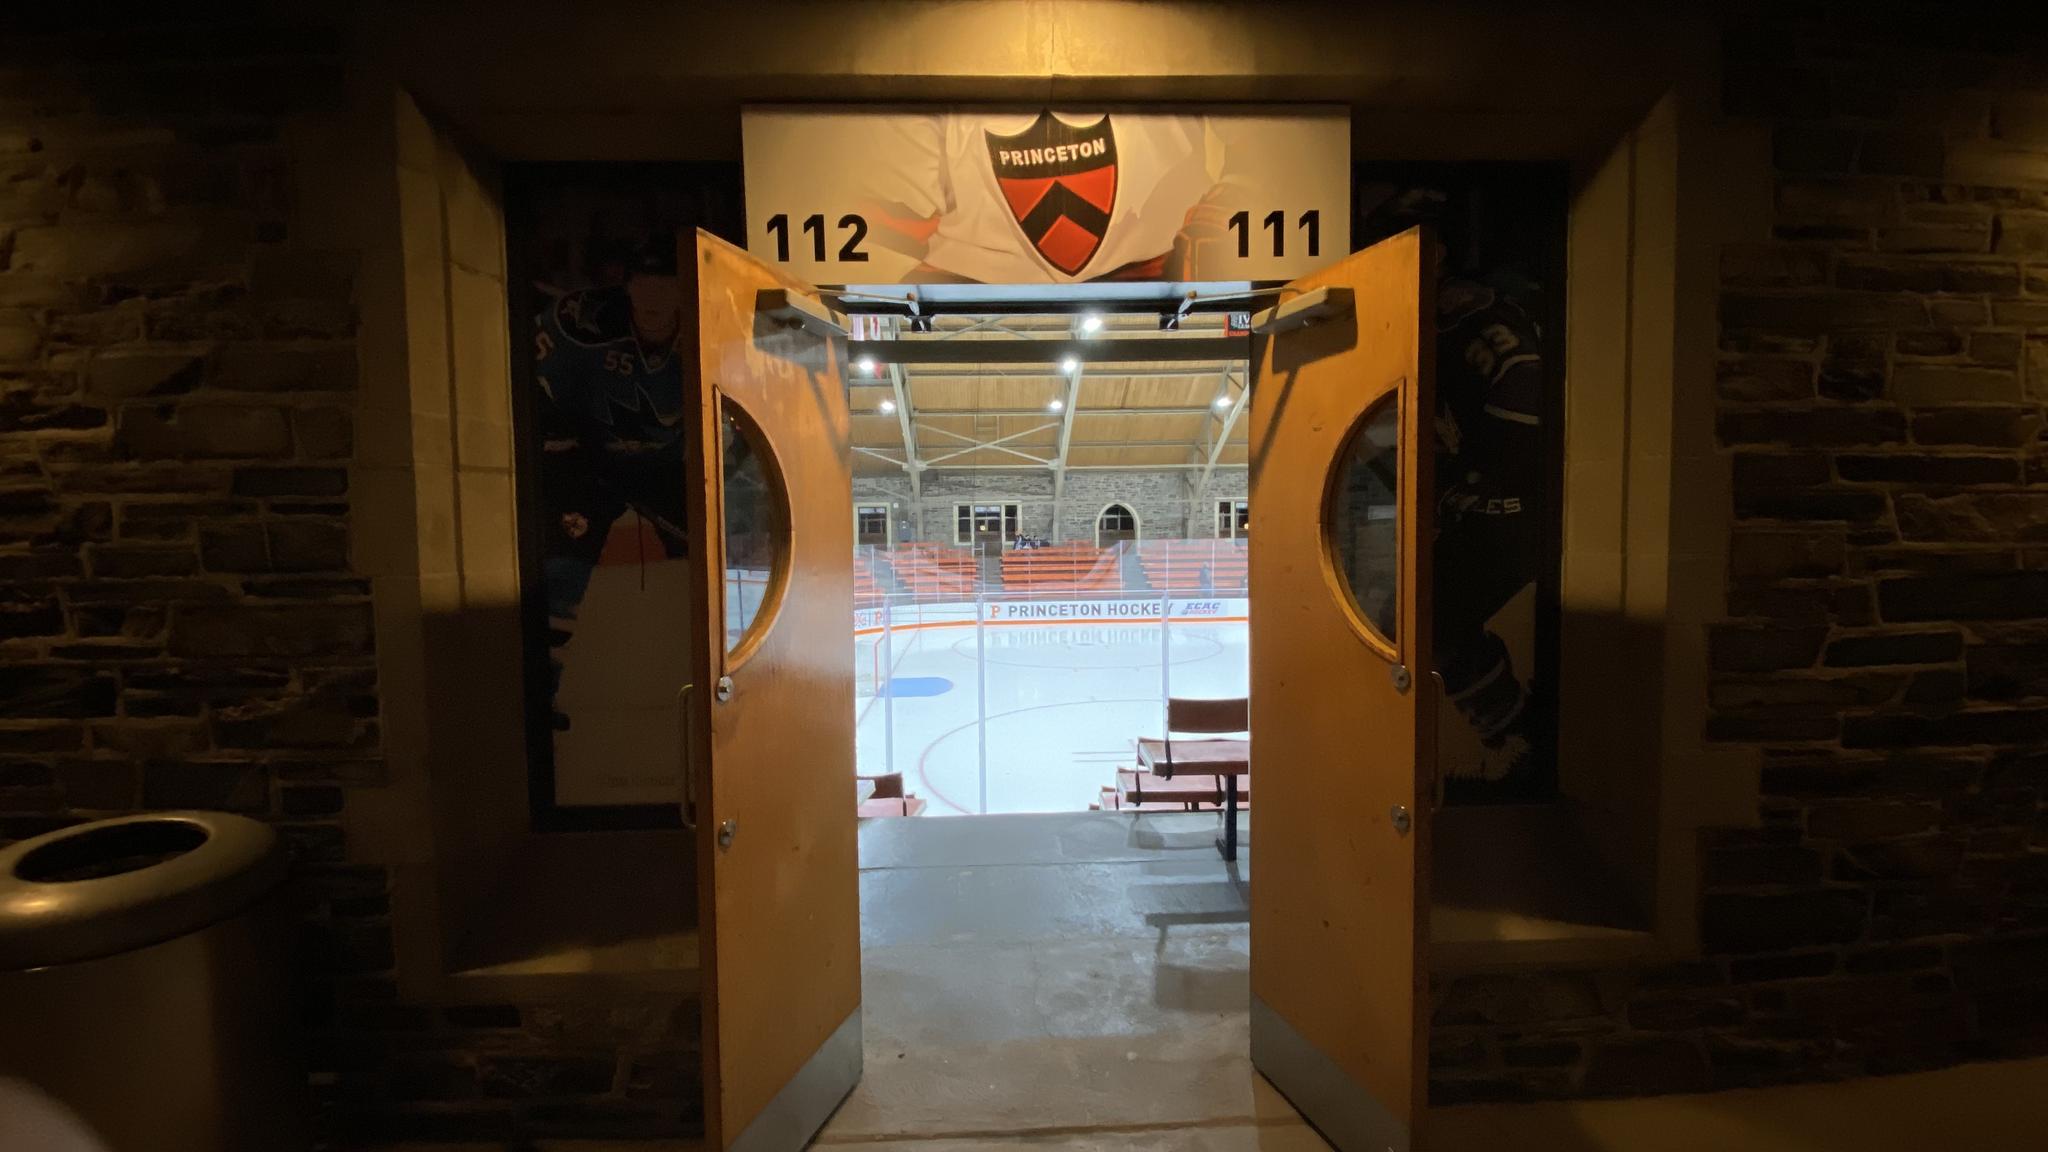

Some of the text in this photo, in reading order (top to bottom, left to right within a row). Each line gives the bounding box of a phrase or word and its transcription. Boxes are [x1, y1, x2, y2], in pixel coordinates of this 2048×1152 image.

[999, 137, 1106, 166] PRINCETON
[766, 213, 869, 262] 112
[1228, 209, 1320, 258] 111
[603, 349, 634, 375] 55
[1008, 603, 1101, 617] PRINCETON
[1185, 602, 1221, 610] ECAC
